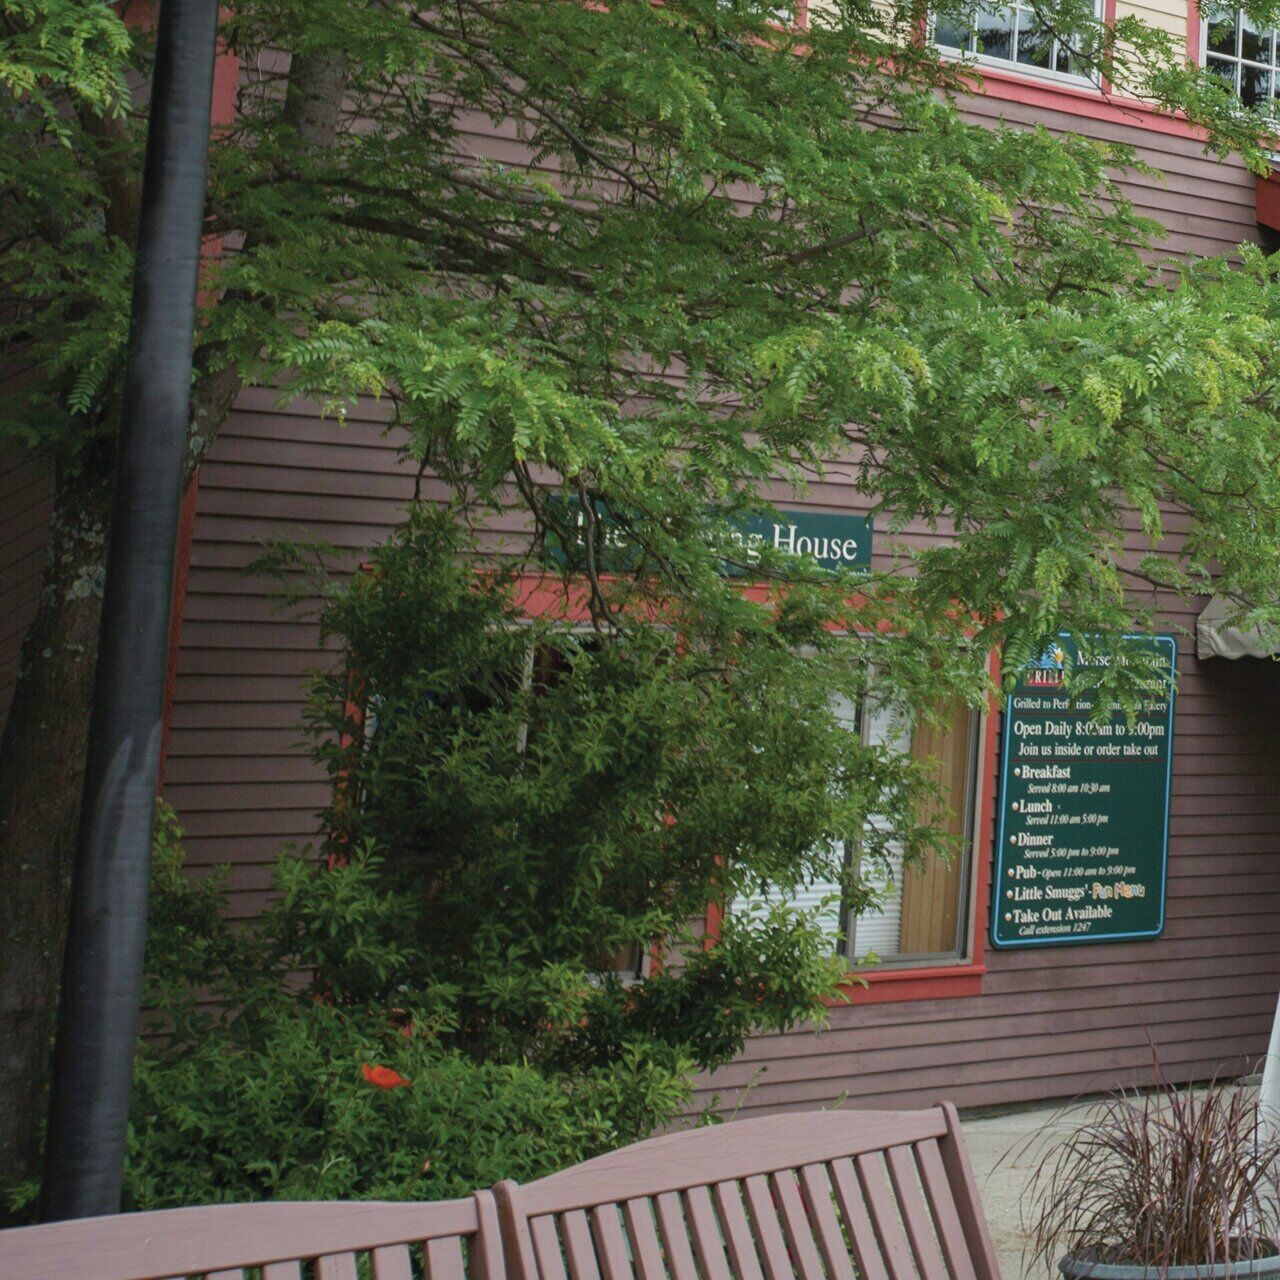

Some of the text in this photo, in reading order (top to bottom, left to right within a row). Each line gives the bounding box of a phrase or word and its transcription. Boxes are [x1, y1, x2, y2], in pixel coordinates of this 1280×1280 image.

[773, 523, 858, 562] House
[1077, 650, 1110, 666] Mrse
[1014, 697, 1041, 709] Grilled
[1043, 700, 1051, 709] to
[1014, 720, 1042, 739] Open
[1045, 720, 1073, 739] Daily
[1115, 723, 1126, 736] to
[1019, 742, 1159, 756] Join us inside or order take out
[1022, 764, 1071, 779] Breakfast
[1027, 782, 1111, 794] Served 8:00 am 10:30 am
[1020, 799, 1053, 813] Lunch
[1026, 814, 1109, 826] Served 11:00 am 5:00 pm
[1018, 832, 1054, 846] Dinner
[1024, 846, 1119, 860] Served 5:00 pm to 9:00 pm
[1063, 866, 1084, 877] 11:00
[1084, 867, 1097, 876] am
[1098, 866, 1106, 876] to
[1106, 865, 1123, 876] 9:00
[1123, 866, 1136, 877] pm
[1014, 886, 1043, 901] Little
[1013, 904, 1112, 923] Take Out Available
[1019, 924, 1035, 936] Call
[1036, 923, 1071, 935] extension
